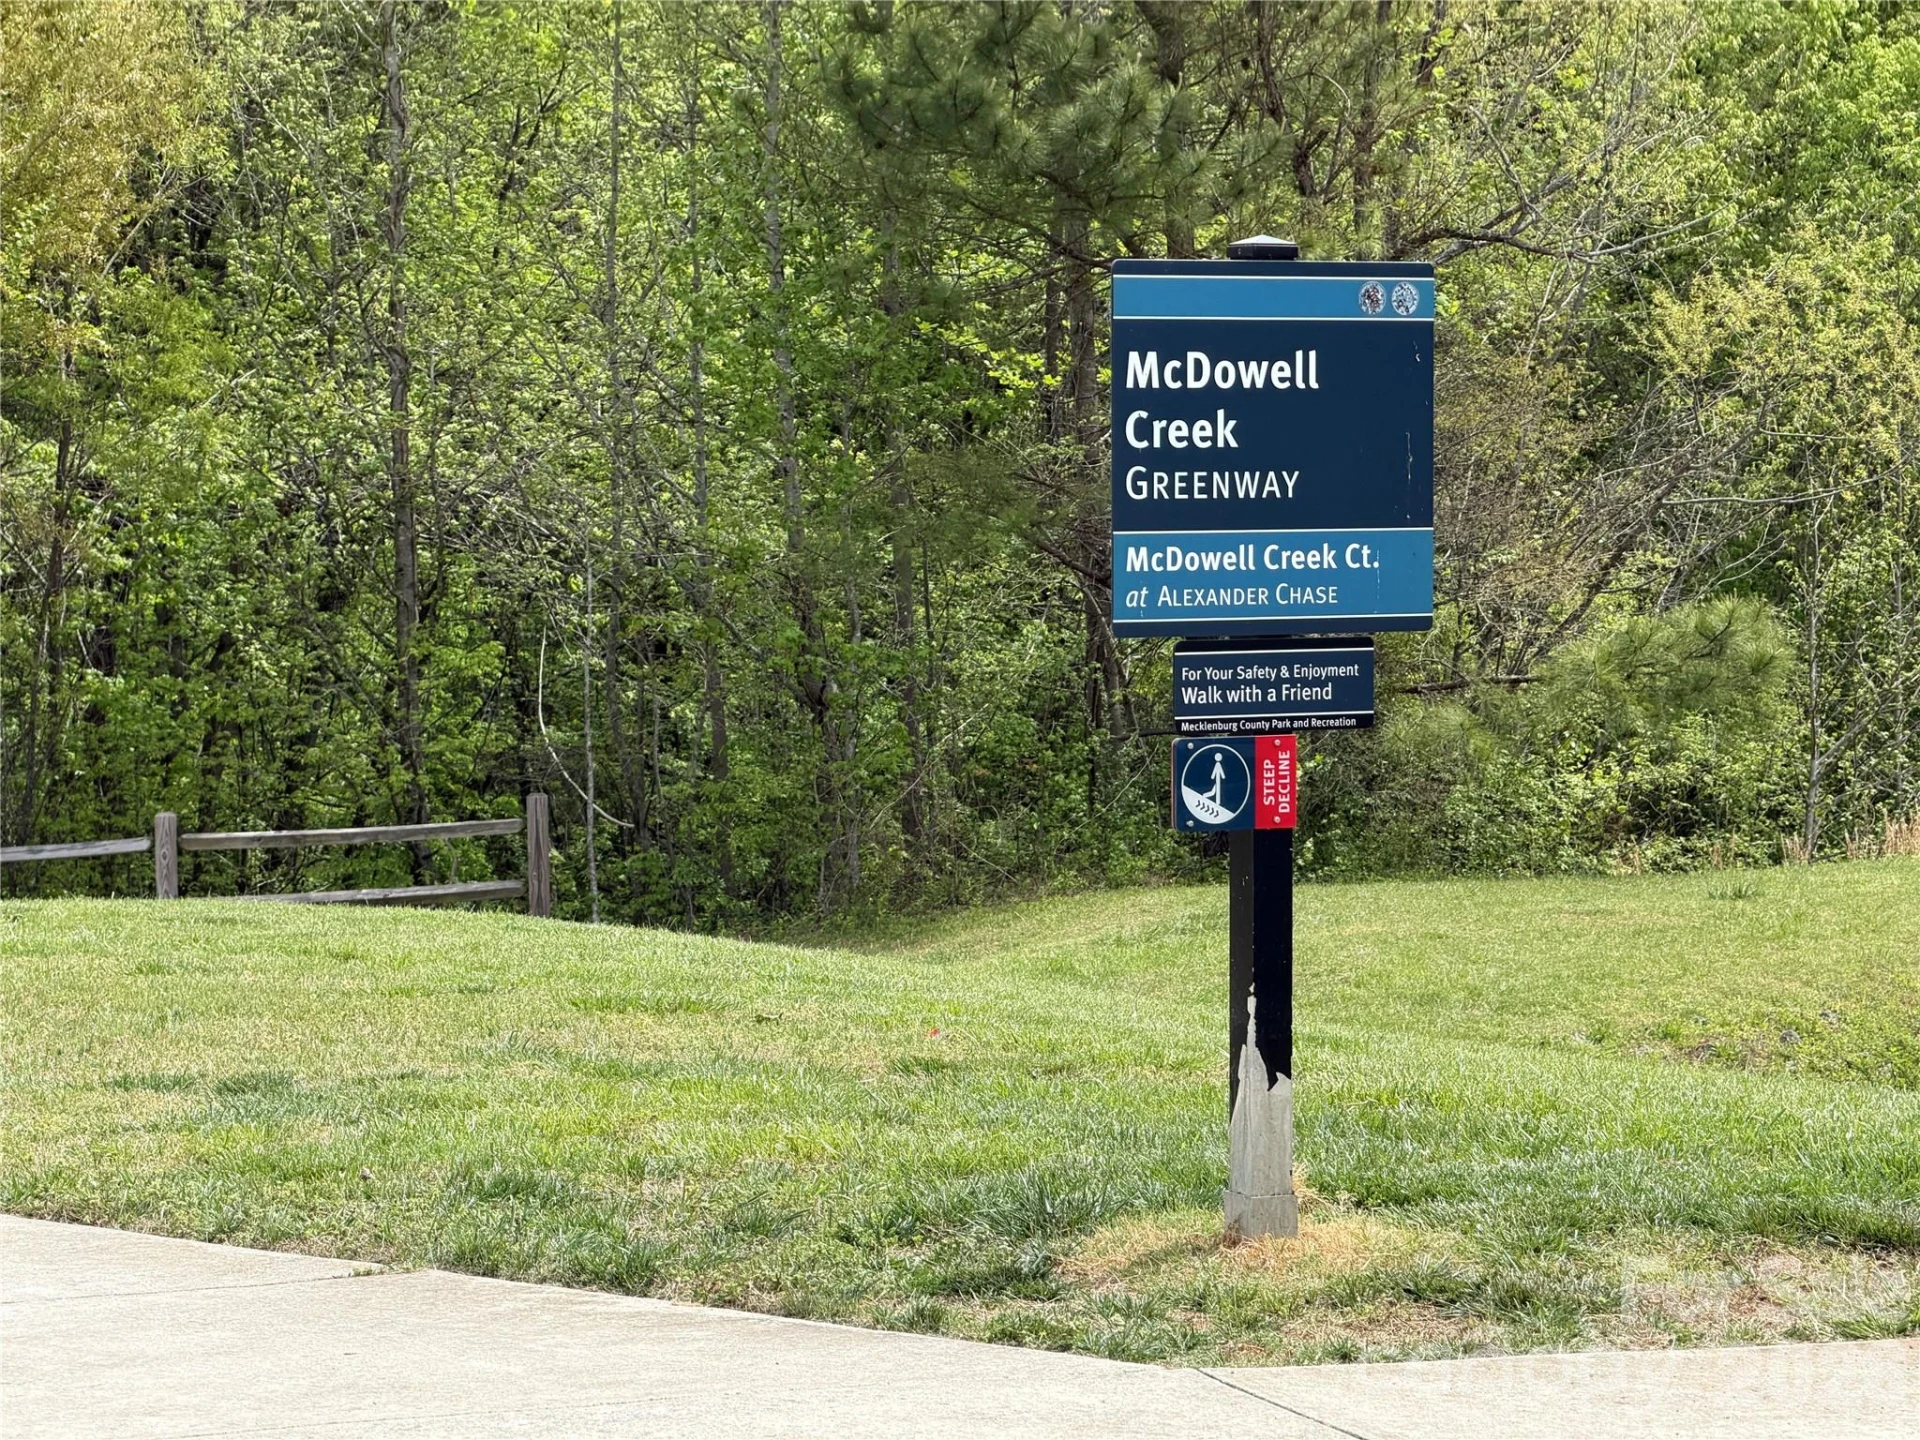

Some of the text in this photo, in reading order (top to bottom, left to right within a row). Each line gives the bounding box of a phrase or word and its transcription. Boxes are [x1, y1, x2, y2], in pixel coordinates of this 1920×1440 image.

[1125, 349, 1319, 389] McDowell
[1125, 409, 1239, 449] Creek
[1125, 466, 1300, 500] GREENWAY
[1126, 542, 1379, 572] McDowell Creek Ct.
[1126, 582, 1338, 608] at ALEXANDER CHASE
[1182, 664, 1359, 681] For Your Safety & Enjoyment
[1181, 682, 1333, 704] Walk with a Friend
[1181, 717, 1356, 732] Mecklenburg County Park and Recreation
[1263, 759, 1275, 806] STEEP
[1279, 750, 1290, 813] DECLINE
